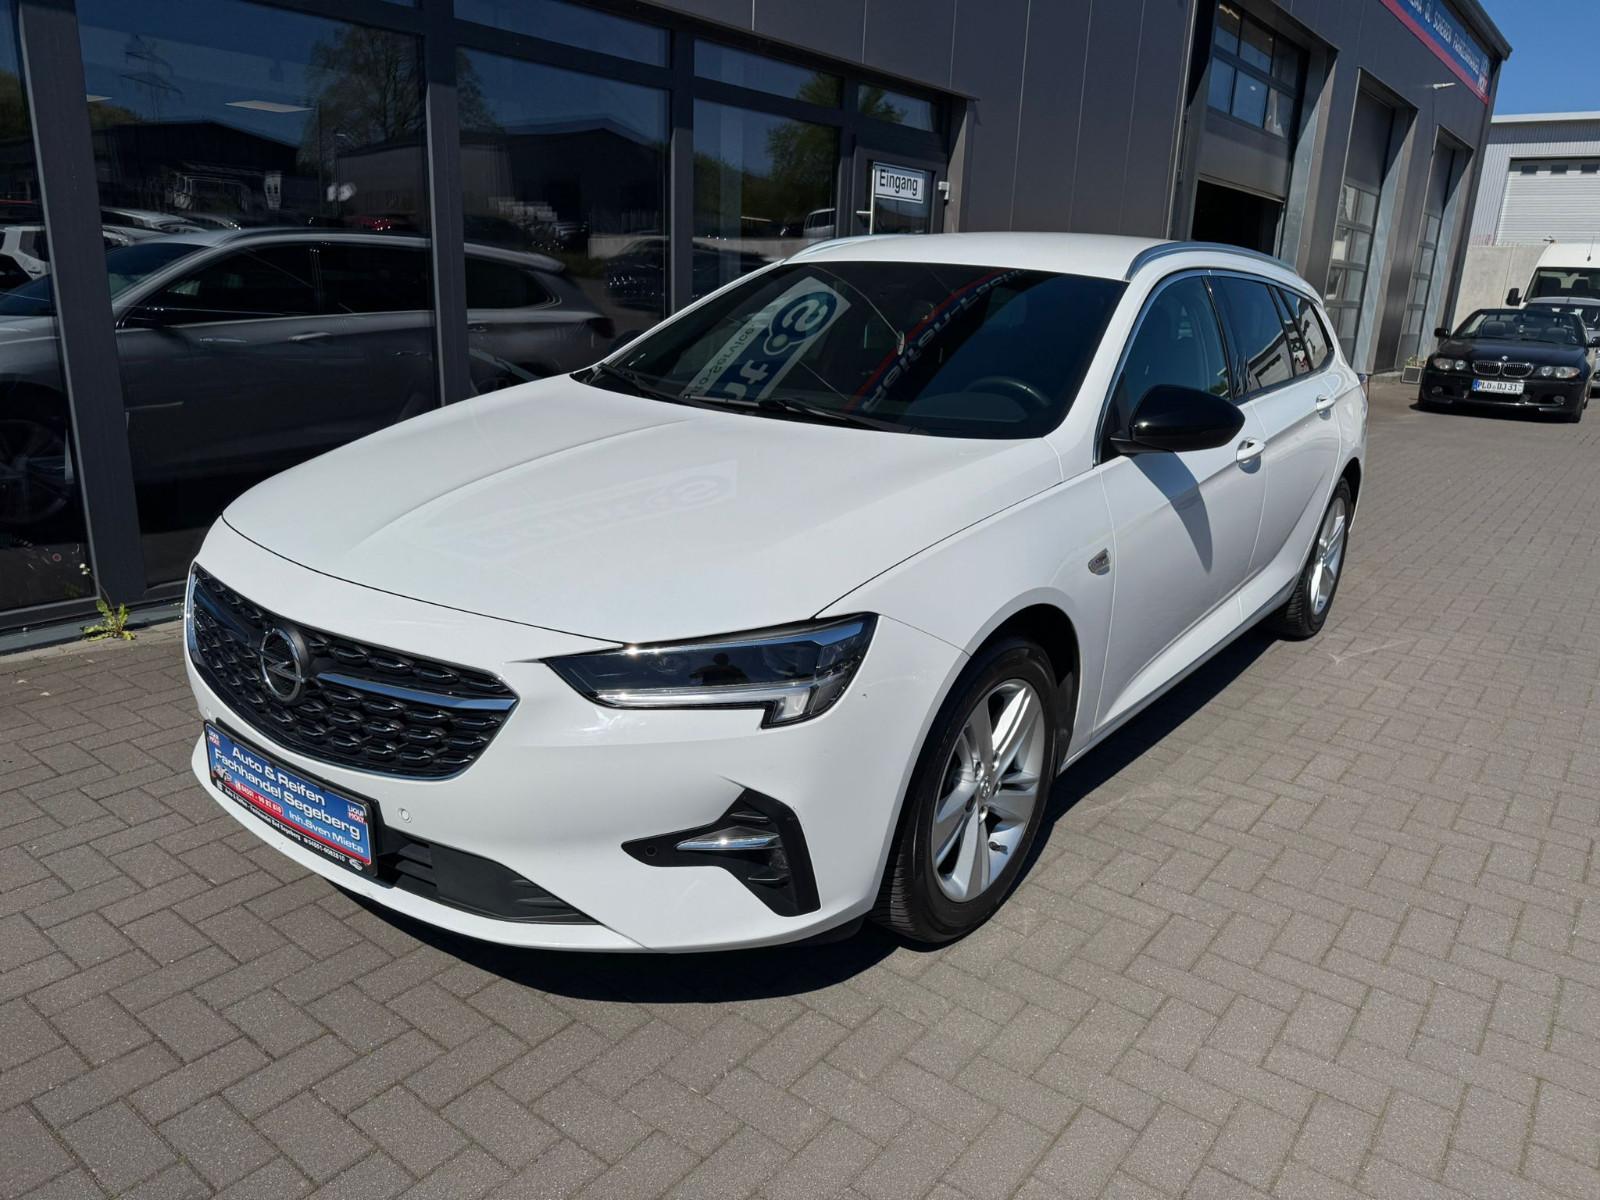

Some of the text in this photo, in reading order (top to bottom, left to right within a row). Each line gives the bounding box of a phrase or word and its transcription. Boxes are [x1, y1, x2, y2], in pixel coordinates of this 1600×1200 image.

[879, 168, 919, 196] Eingang
[214, 747, 361, 841] Fachhandel Segeberg
[232, 747, 326, 806] Auto & Reifen
